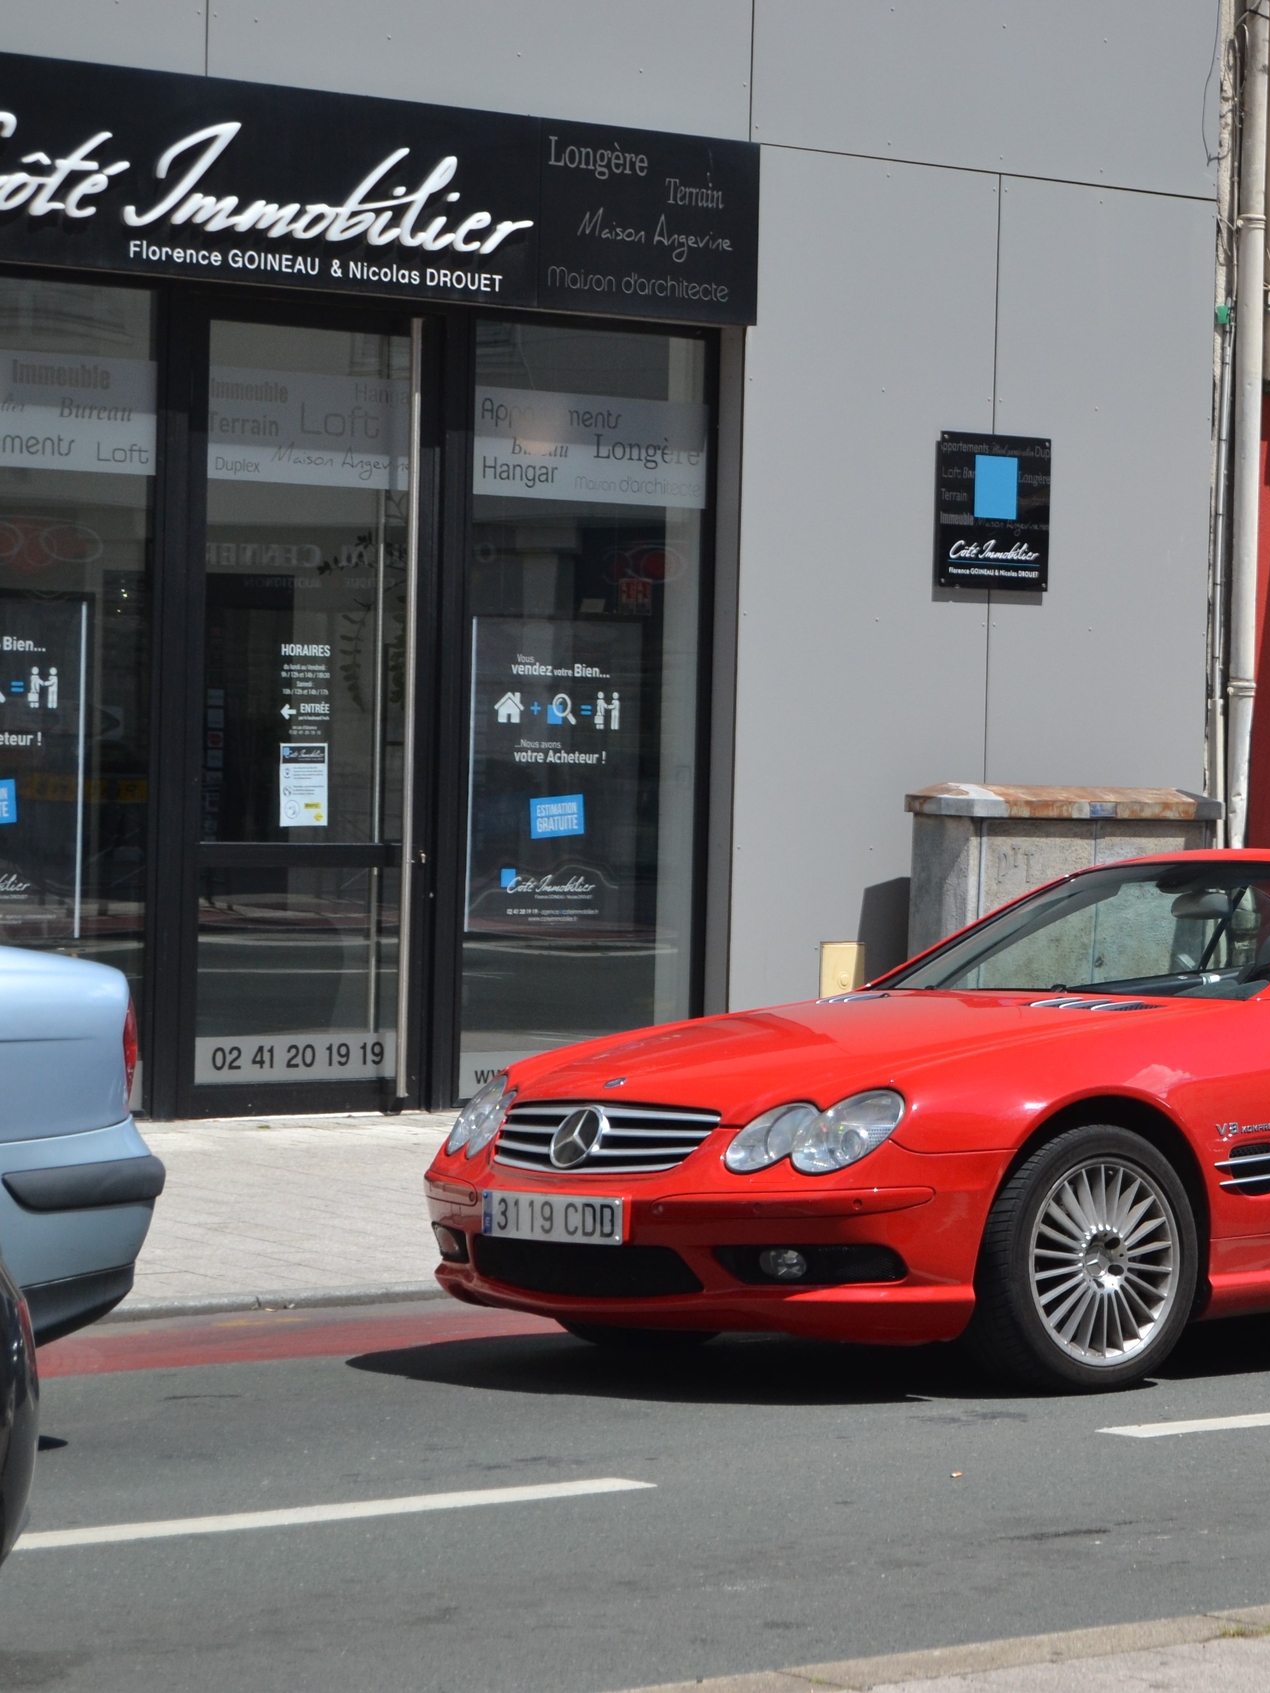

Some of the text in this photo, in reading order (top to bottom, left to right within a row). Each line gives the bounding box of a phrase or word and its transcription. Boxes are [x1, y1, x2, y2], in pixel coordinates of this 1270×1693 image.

[548, 136, 649, 180] Longère
[123, 122, 534, 254] Immobilier
[665, 177, 724, 209] Terrain
[577, 207, 733, 262] Maison Angevine
[129, 241, 503, 292] Florence GOINEAU & Nicolas DROUET
[621, 272, 729, 302] d'architecte
[59, 397, 134, 422] Bureau
[208, 402, 379, 438] Terrain Loft
[96, 442, 150, 464] Loft
[271, 441, 334, 466] Maison
[215, 456, 261, 475] Duplex
[482, 455, 558, 488] Hangar
[941, 488, 967, 501] Terrain
[949, 539, 1040, 561] Côté Immobilier
[281, 644, 331, 657] HORAIRES
[517, 653, 534, 663] Vous
[512, 663, 610, 678] vendez votre Bien...
[300, 701, 330, 713] ENTRÉE
[541, 740, 562, 749] avons
[514, 750, 544, 762] votre
[546, 750, 599, 764] Acheteur
[536, 802, 578, 817] ESTIMATION
[536, 815, 578, 832] GRATUITE
[507, 874, 596, 894] Côté Immobilier
[212, 1041, 384, 1071] 02 41 20 19 19
[1215, 1122, 1239, 1137] V8
[497, 1198, 615, 1239] 3119 CDD
